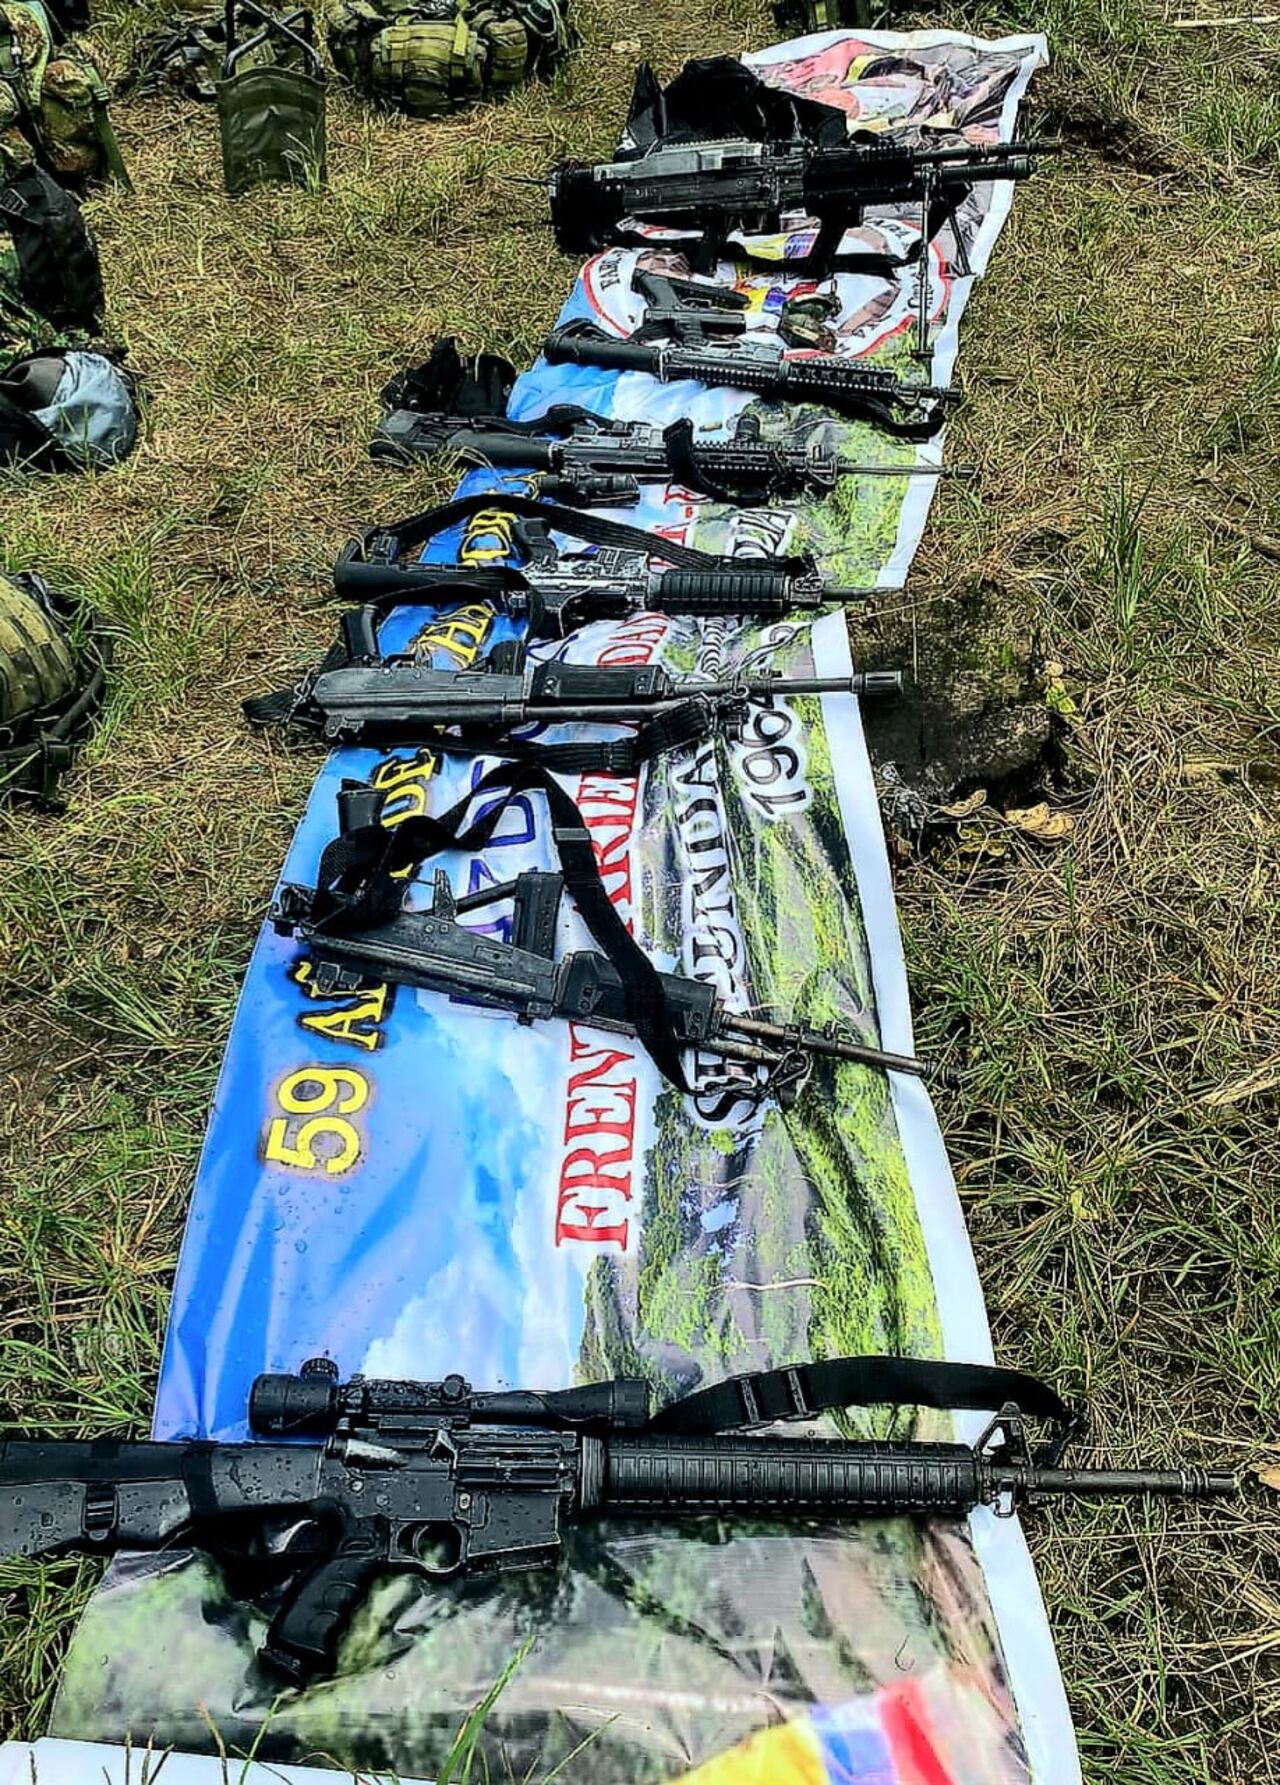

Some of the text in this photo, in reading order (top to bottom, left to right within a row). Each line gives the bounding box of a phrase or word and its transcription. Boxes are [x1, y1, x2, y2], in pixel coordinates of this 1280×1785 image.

[674, 747, 760, 1125] SEUNDA
[263, 1067, 369, 1175] 59
[555, 1019, 637, 1252] FREN
